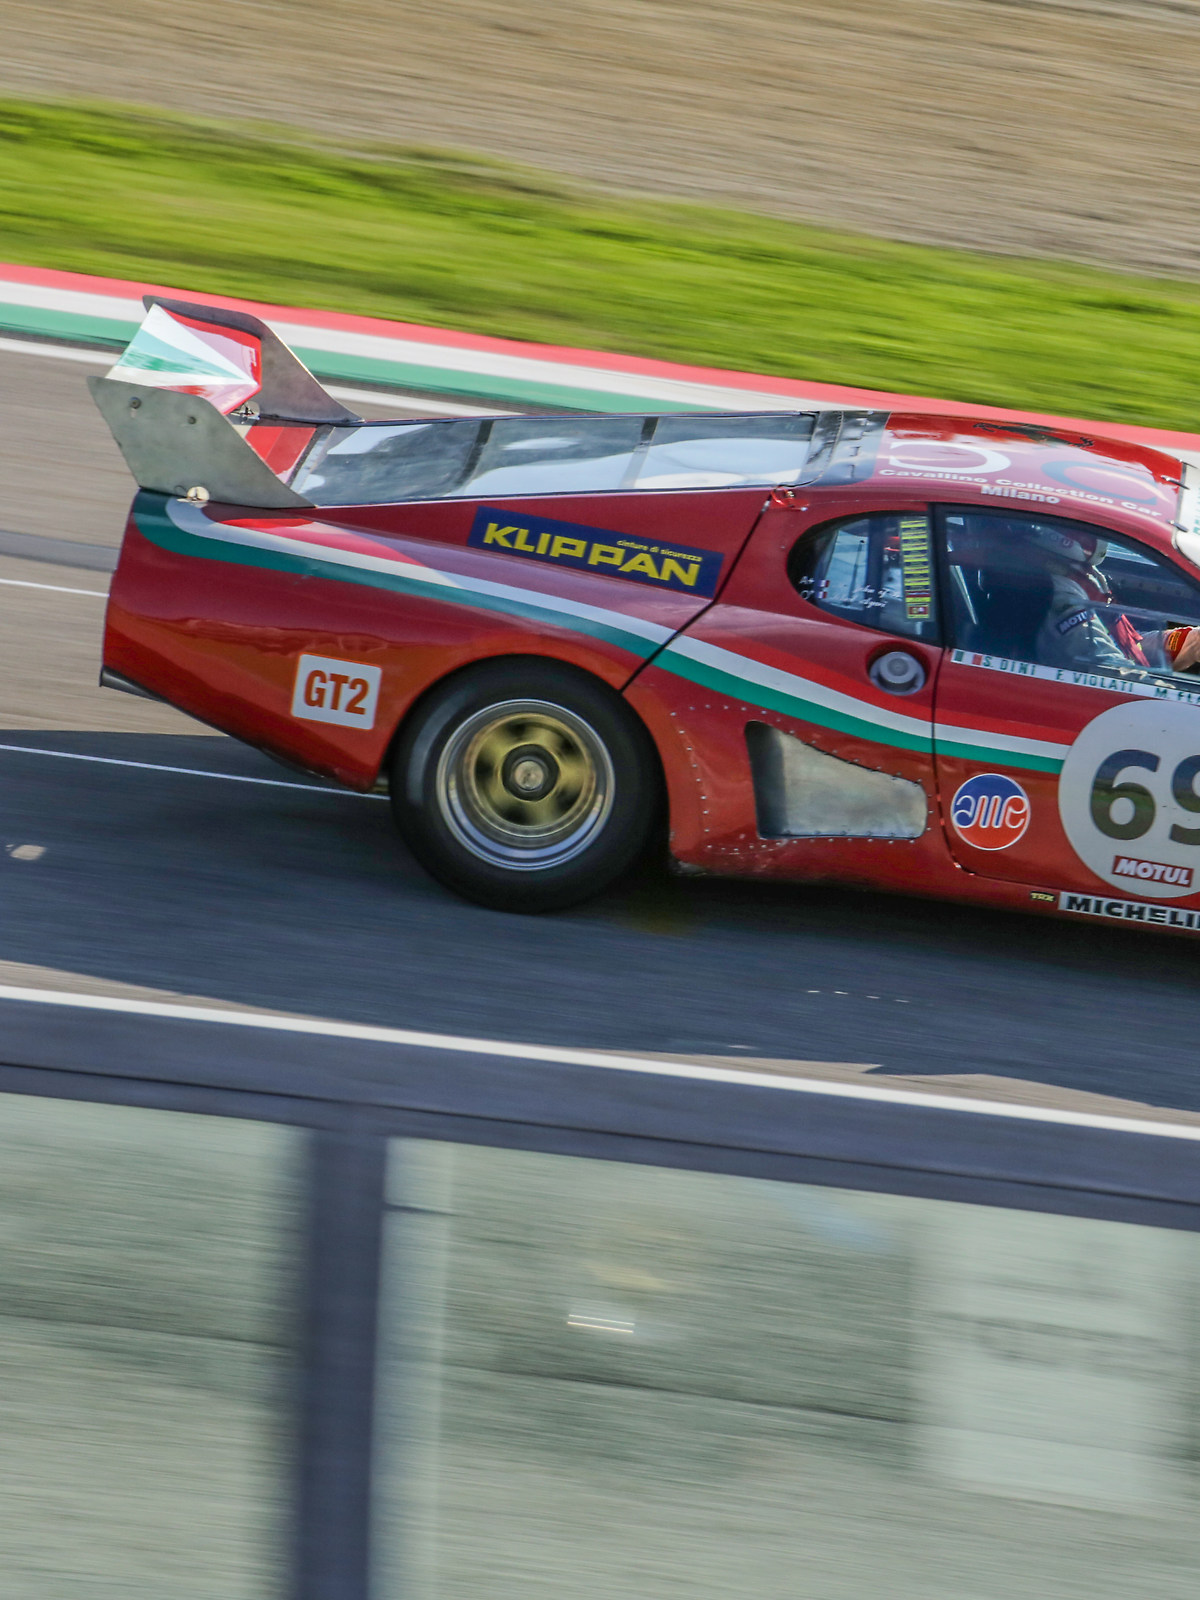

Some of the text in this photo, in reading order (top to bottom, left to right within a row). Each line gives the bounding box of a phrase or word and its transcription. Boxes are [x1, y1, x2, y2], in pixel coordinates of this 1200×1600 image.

[878, 469, 988, 483] Cavallino
[995, 479, 1114, 504] Collection
[981, 485, 1060, 504] Milano
[483, 522, 700, 587] KLIPPAN
[304, 670, 369, 715] GT2
[1000, 659, 1036, 676] DINI
[1073, 672, 1134, 692] VIOLATI
[1115, 858, 1190, 885] MOTUL
